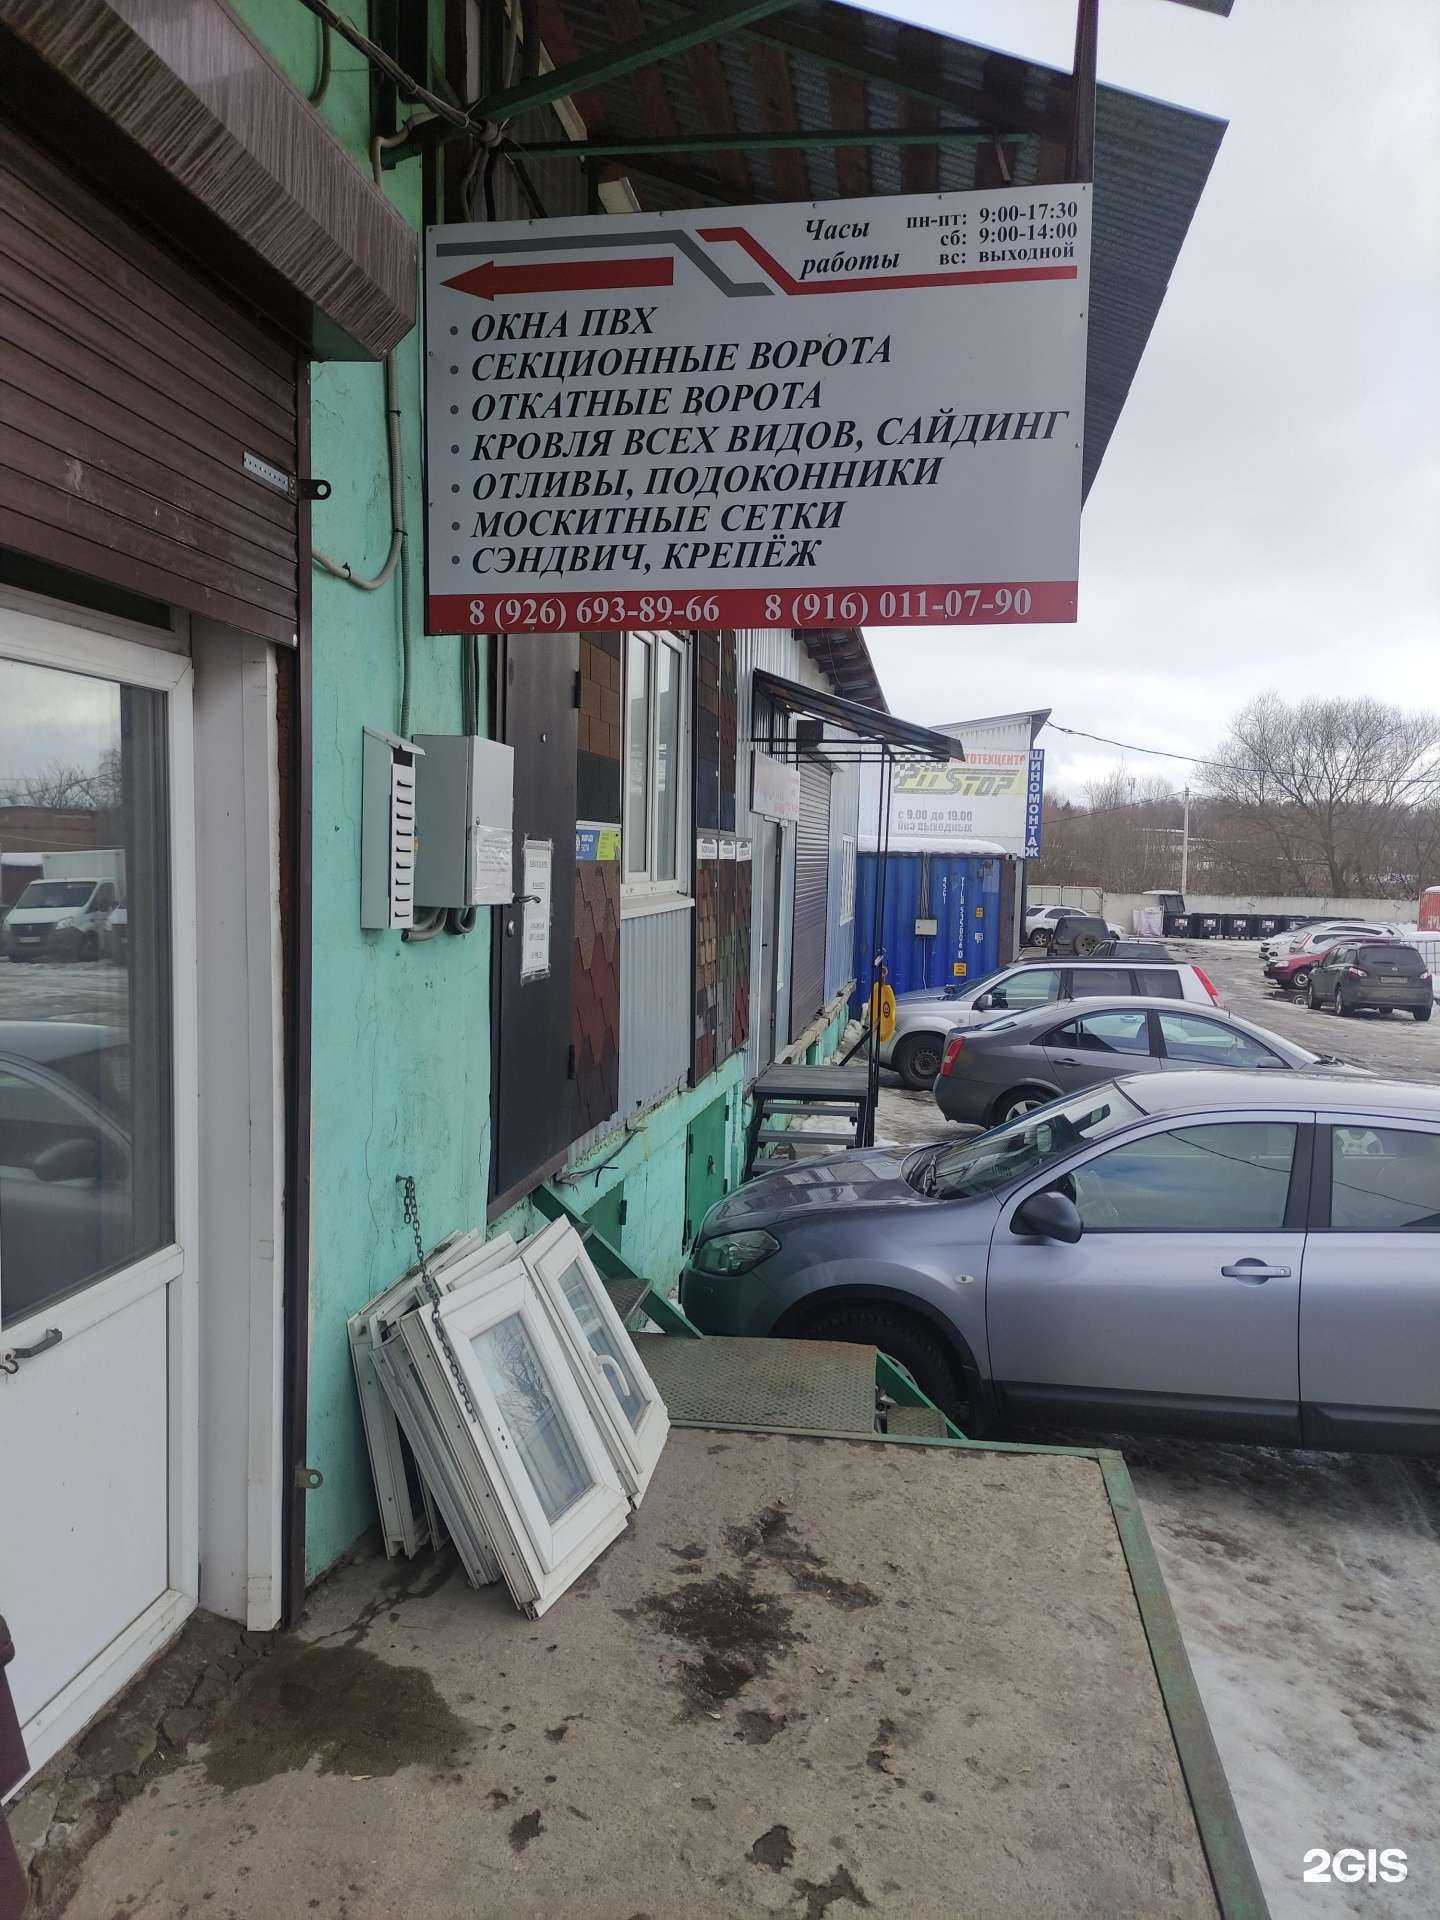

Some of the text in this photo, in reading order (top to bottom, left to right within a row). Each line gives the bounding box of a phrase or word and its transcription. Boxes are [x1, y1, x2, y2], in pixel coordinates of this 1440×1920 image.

[805, 219, 870, 241] Часы
[906, 201, 1078, 229] пн-пт: 9:00-17:30
[940, 222, 1078, 246] сб: 9:00-14:00
[799, 251, 901, 281] работы
[939, 241, 1074, 266] вс: выходной
[471, 306, 658, 342] ОКНА ПВХ
[471, 335, 892, 384] СЕКЦИОННЫЕ ВОРОТА
[471, 380, 822, 422] ОТКАТНЫЕ ВОРОТА
[470, 407, 1070, 461] КРОВЛЯ ВСЕХ ВИДОВ, САЙДИНГ
[472, 456, 944, 501] ОТЛИВЫ, ПОДОКОННИКИ
[470, 500, 848, 538] МОСКИТНЫЕ СЕТКИ
[472, 534, 822, 580] СЭНДВИЧ, КРЕПЁЖ
[469, 595, 720, 632] 8 (926) 693-89-66
[765, 588, 1032, 626] 8 (916) 011-07-90
[951, 752, 1025, 767] ТОТЕХЦЕНТР
[930, 810, 944, 821] до
[948, 810, 973, 821] 19.00
[1025, 751, 1043, 857] ШИНОМОНТАЖ
